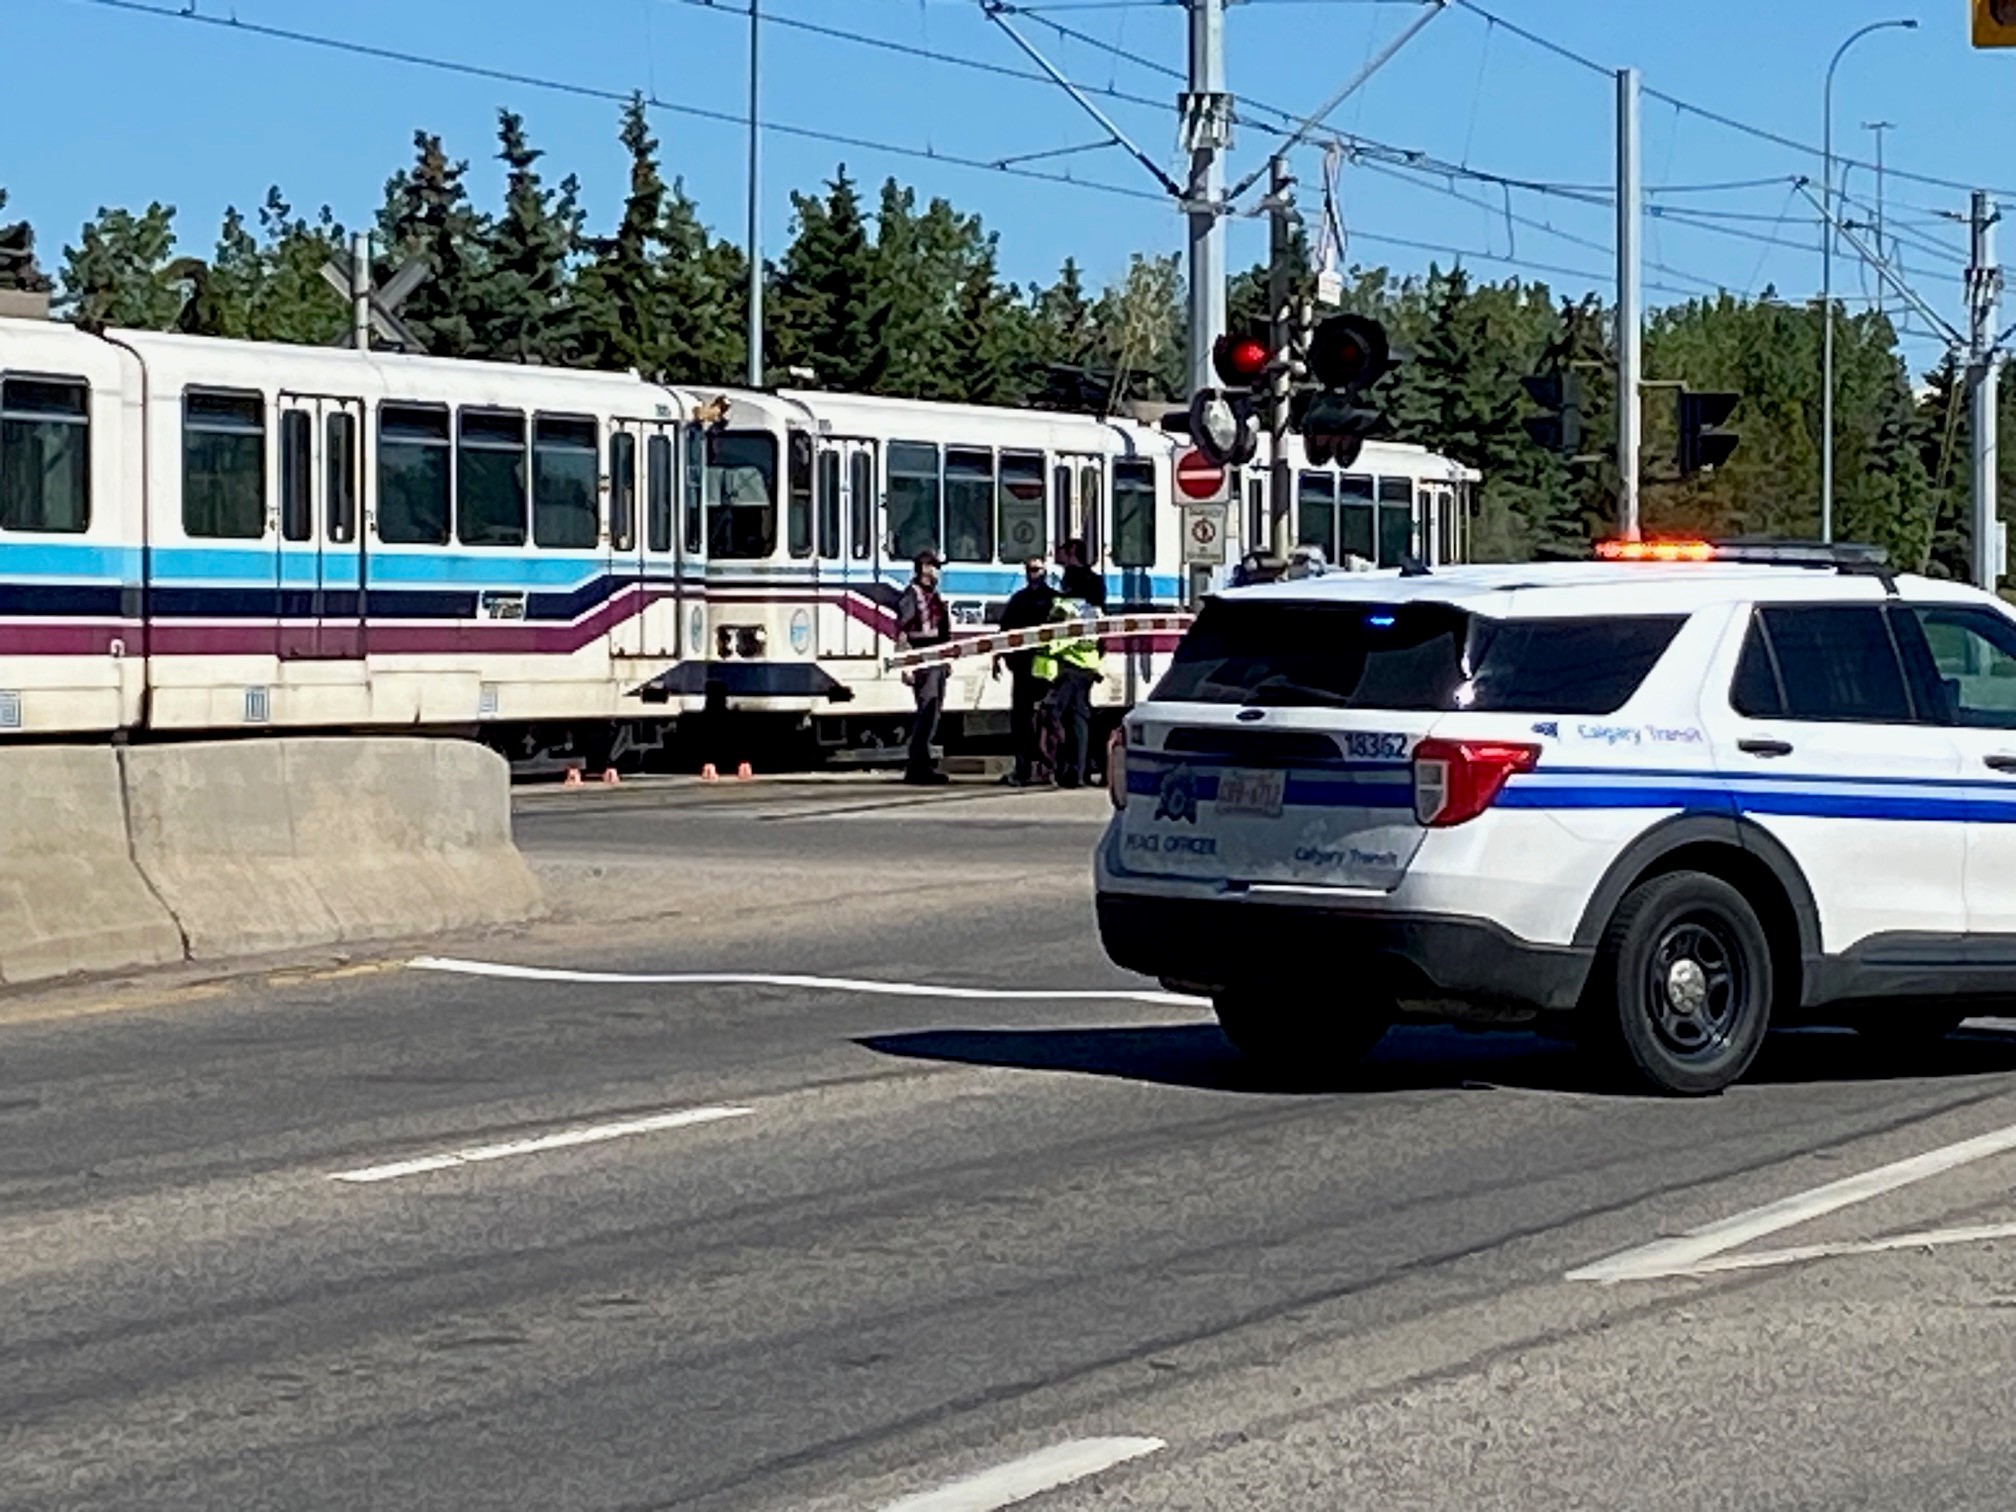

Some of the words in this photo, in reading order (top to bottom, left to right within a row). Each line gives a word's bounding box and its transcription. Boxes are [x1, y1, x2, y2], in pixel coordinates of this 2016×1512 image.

[1577, 723, 1641, 746] Calgary
[1344, 732, 1408, 760] 18362
[1163, 836, 1217, 855] OFFICER
[1294, 846, 1345, 866] Calgary
